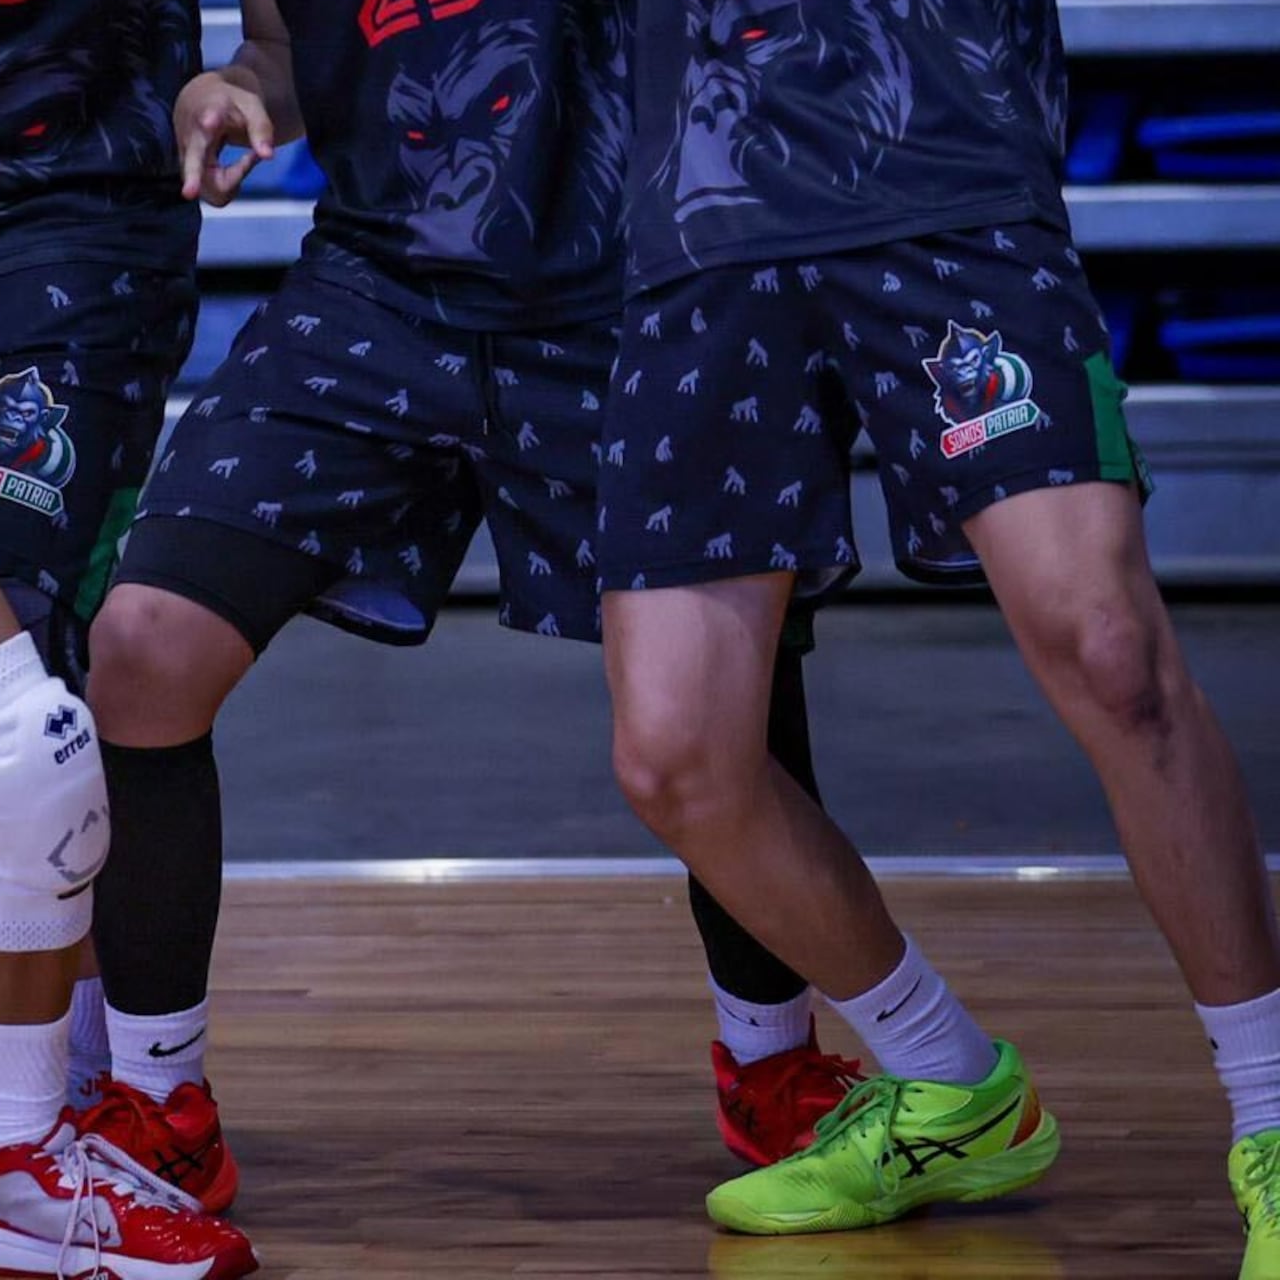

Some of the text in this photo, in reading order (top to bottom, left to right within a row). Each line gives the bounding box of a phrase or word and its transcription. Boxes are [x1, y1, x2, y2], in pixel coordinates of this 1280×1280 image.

[946, 404, 1030, 453] SOMOS PATRIA
[3, 475, 56, 510] PATRIA
